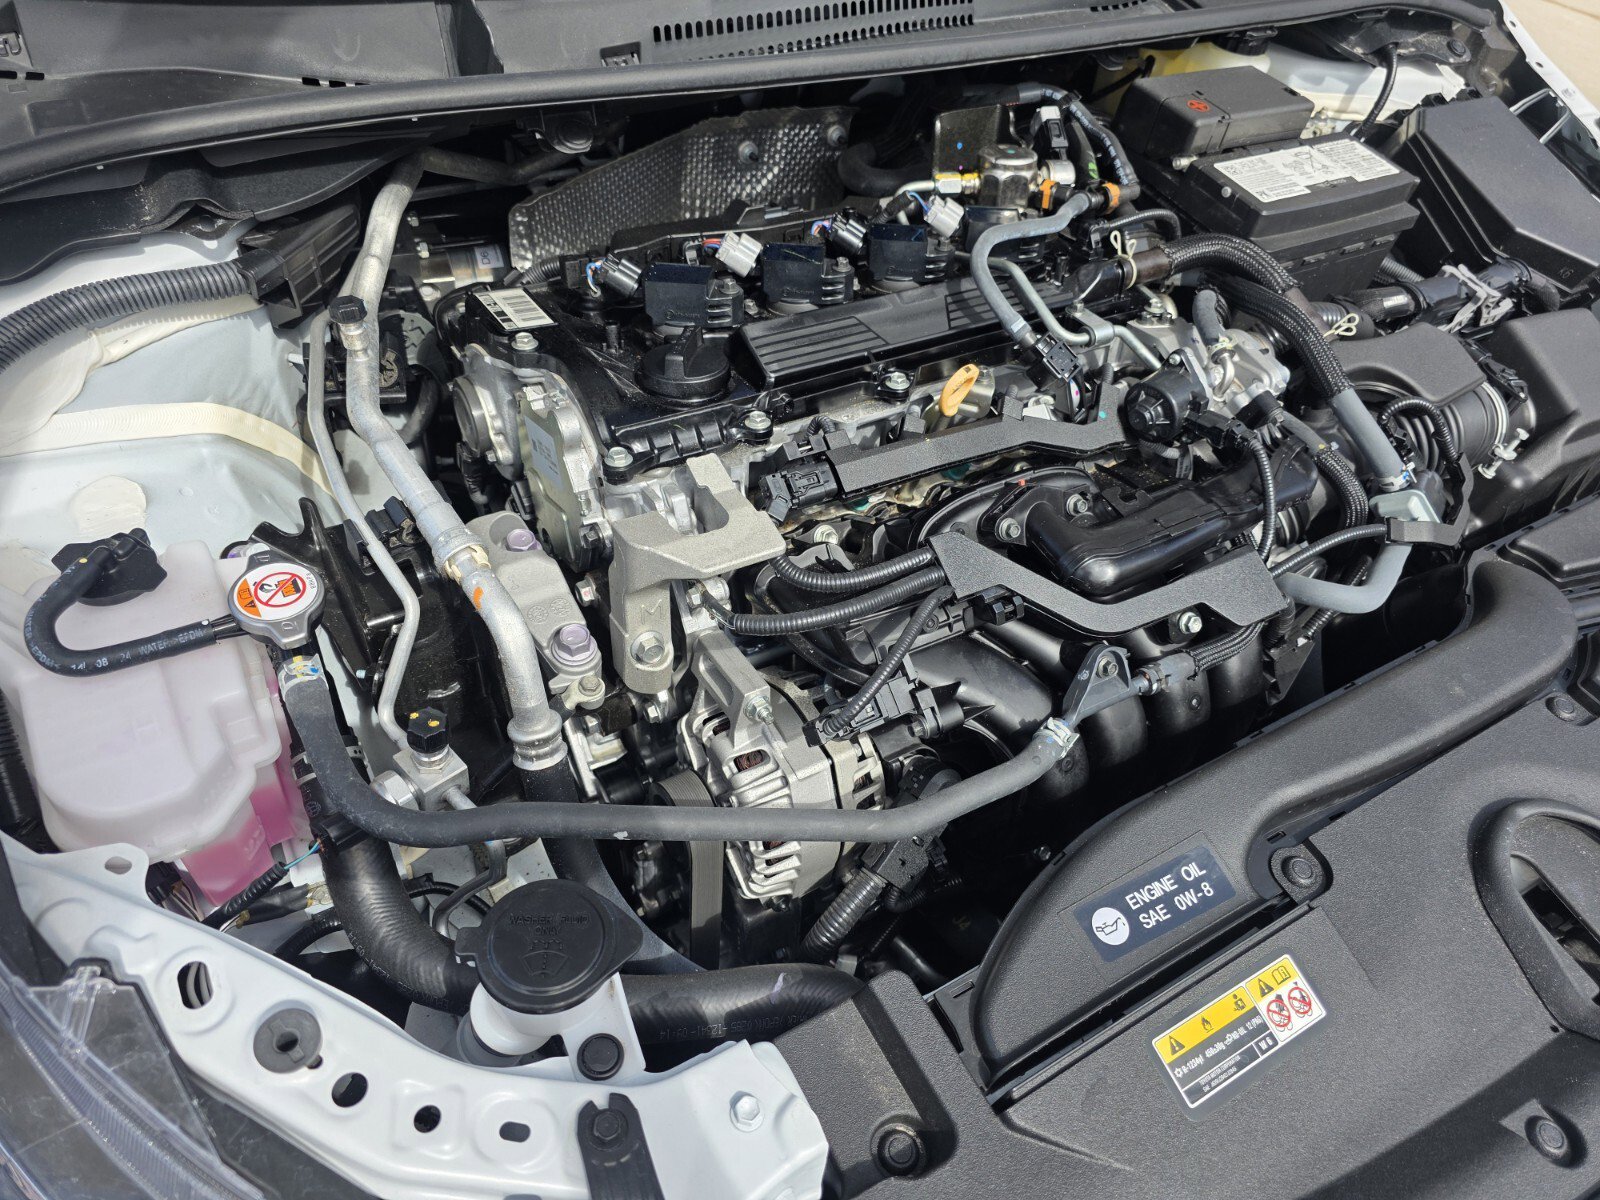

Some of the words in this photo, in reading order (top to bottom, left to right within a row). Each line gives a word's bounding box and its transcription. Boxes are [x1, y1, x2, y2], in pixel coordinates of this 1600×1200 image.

[1125, 874, 1178, 910] ENGINE
[1181, 862, 1207, 881] OIL
[1138, 904, 1171, 929] SAE
[1174, 882, 1214, 911] 0W-8
[509, 914, 552, 925] WASHER
[561, 914, 590, 924] FLUID
[535, 926, 559, 936] ONLY
[1266, 1036, 1274, 1046] 6
